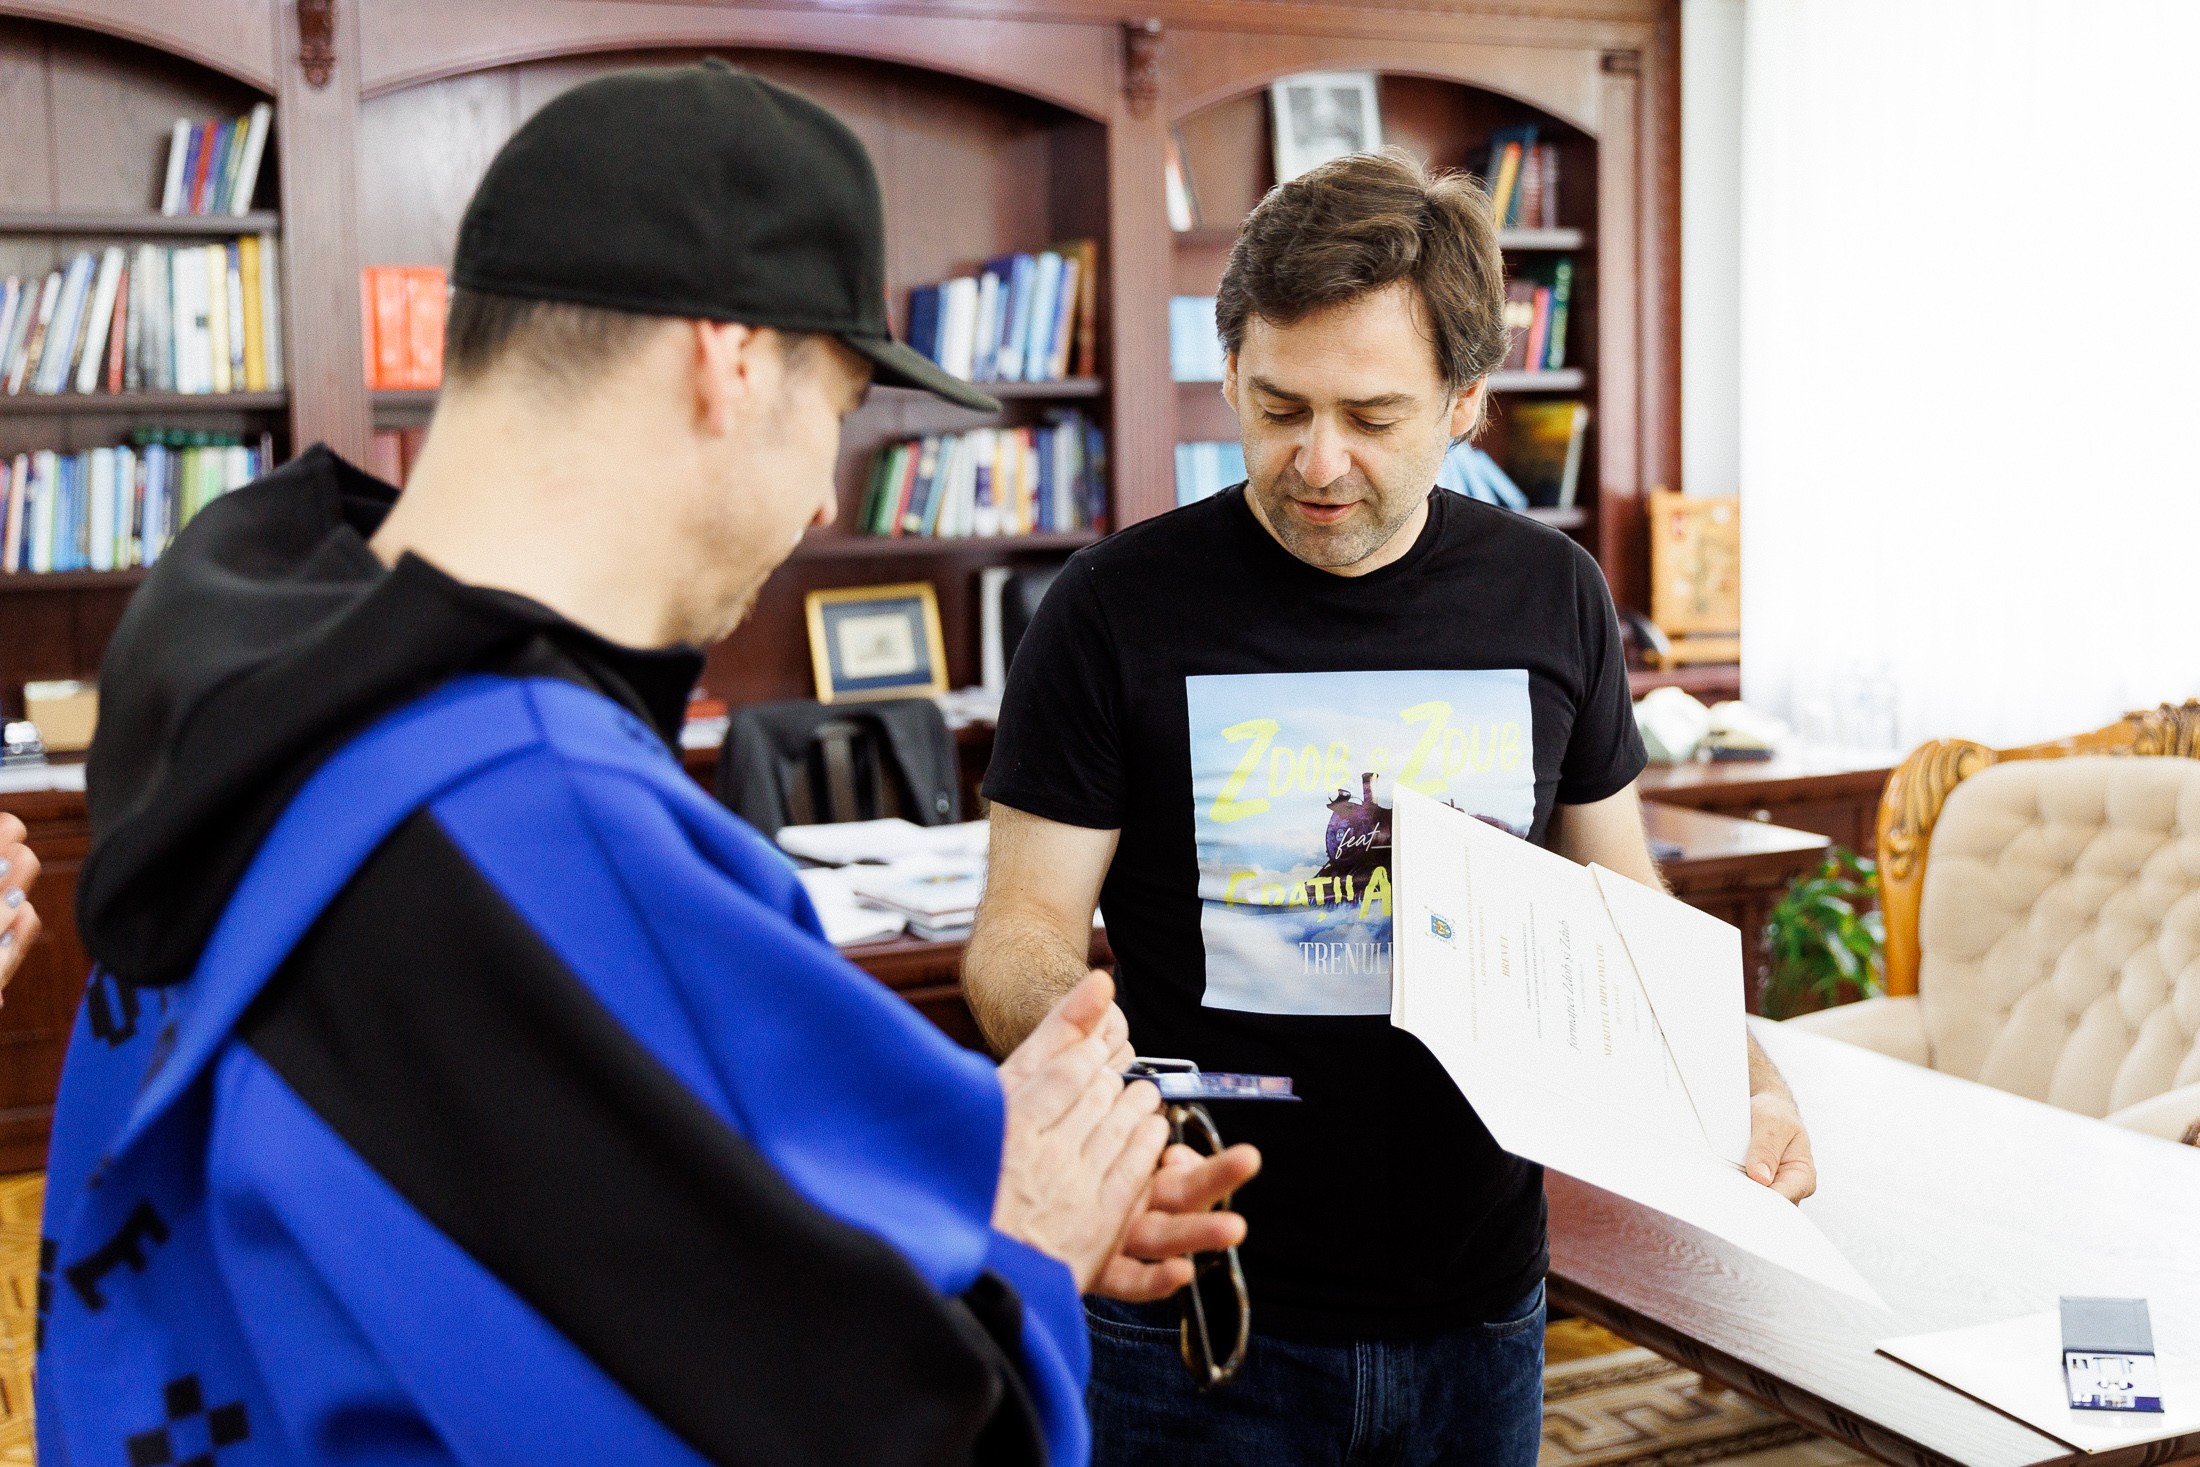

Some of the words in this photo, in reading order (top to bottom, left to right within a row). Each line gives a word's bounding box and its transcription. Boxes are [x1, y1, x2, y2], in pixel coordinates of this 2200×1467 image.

[1210, 718, 1351, 822] ZDOB
[1398, 700, 1523, 796] ZDUB
[1299, 941, 1393, 975] TRENUL
